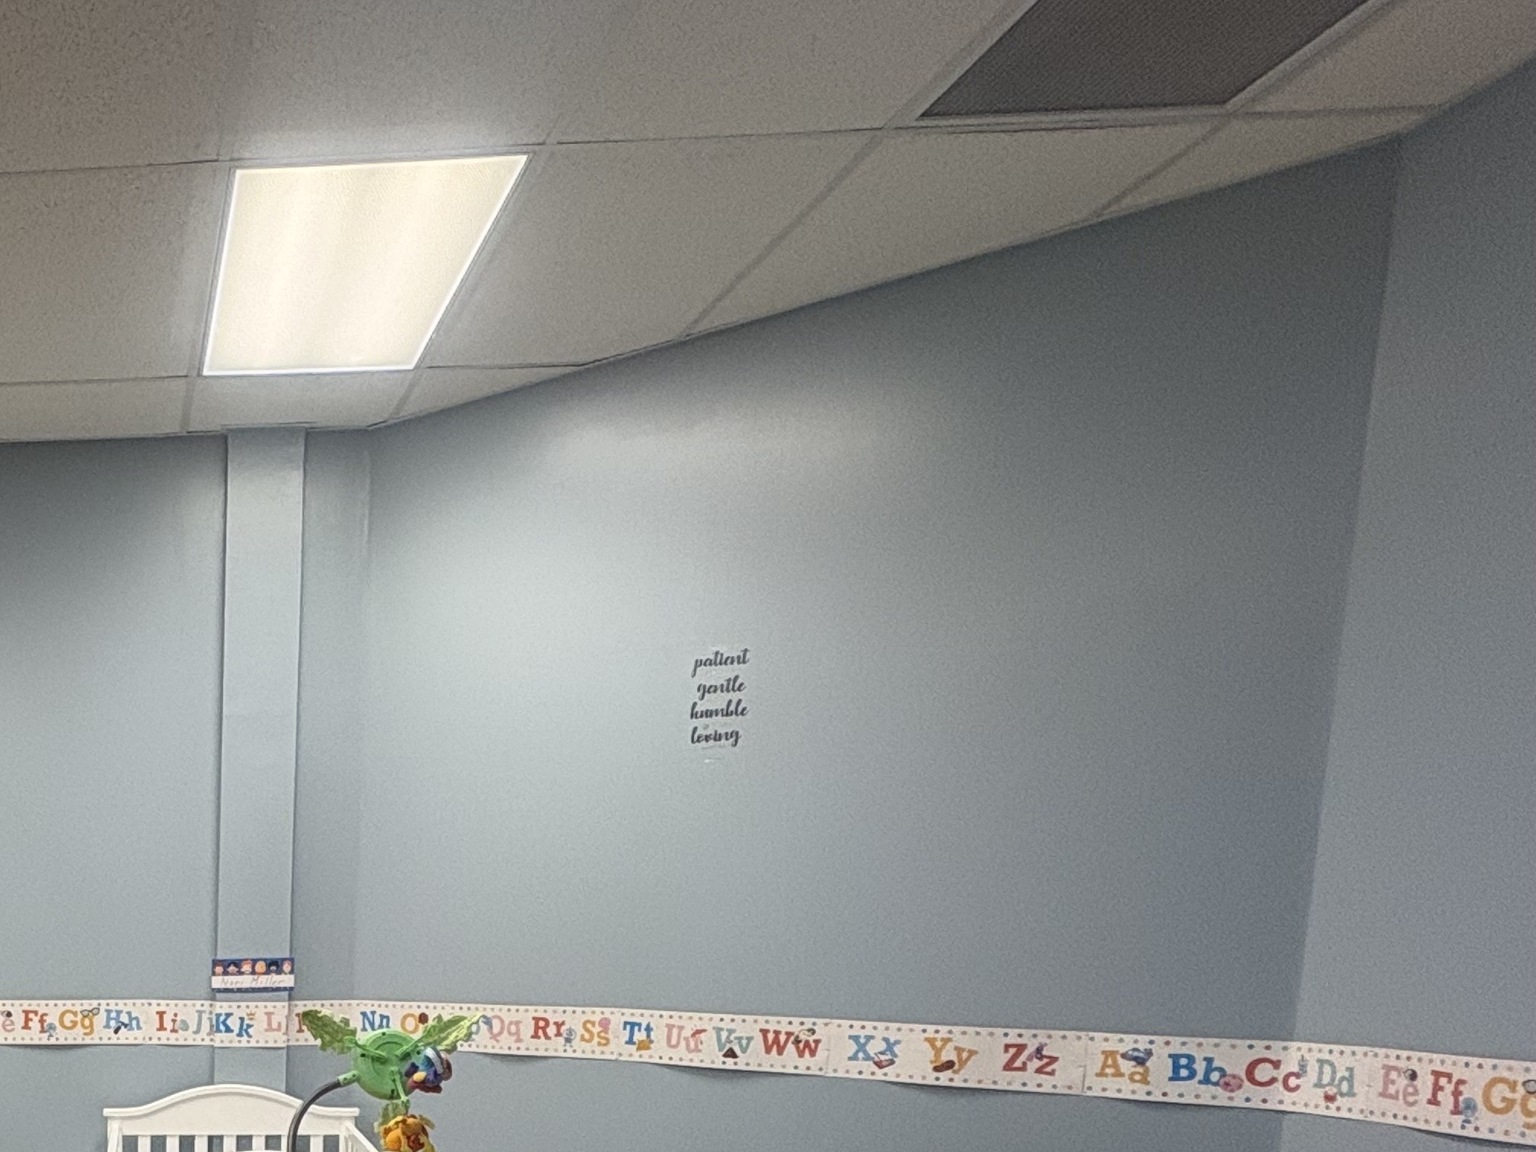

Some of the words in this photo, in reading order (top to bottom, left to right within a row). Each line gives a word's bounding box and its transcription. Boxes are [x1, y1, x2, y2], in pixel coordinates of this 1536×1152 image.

[691, 648, 751, 678] patient
[696, 675, 747, 701] gentle
[690, 698, 749, 720] humble
[691, 726, 742, 747] loving
[21, 1009, 49, 1034] Ff
[58, 1008, 96, 1036] Gg
[102, 1008, 142, 1032] Hh
[155, 1009, 179, 1033] Ii
[214, 1012, 254, 1038] Kk
[263, 1011, 288, 1034] L
[360, 1010, 391, 1032] Nn
[487, 1014, 523, 1043] Qq
[530, 1016, 566, 1040] Rr
[580, 1019, 611, 1049] Ss
[623, 1020, 654, 1048] Tt
[665, 1023, 704, 1054] Uu
[712, 1025, 754, 1055] Vv
[759, 1028, 822, 1059] Ww
[848, 1034, 901, 1064] Xx
[924, 1036, 979, 1077] Yy
[1002, 1043, 1061, 1078] Zz
[1095, 1050, 1151, 1086] Aa
[1167, 1052, 1229, 1087] Bb
[1244, 1057, 1302, 1093] Cc
[1311, 1057, 1356, 1099] Dd
[1379, 1063, 1420, 1108] Ee
[1426, 1069, 1468, 1116] Ff
